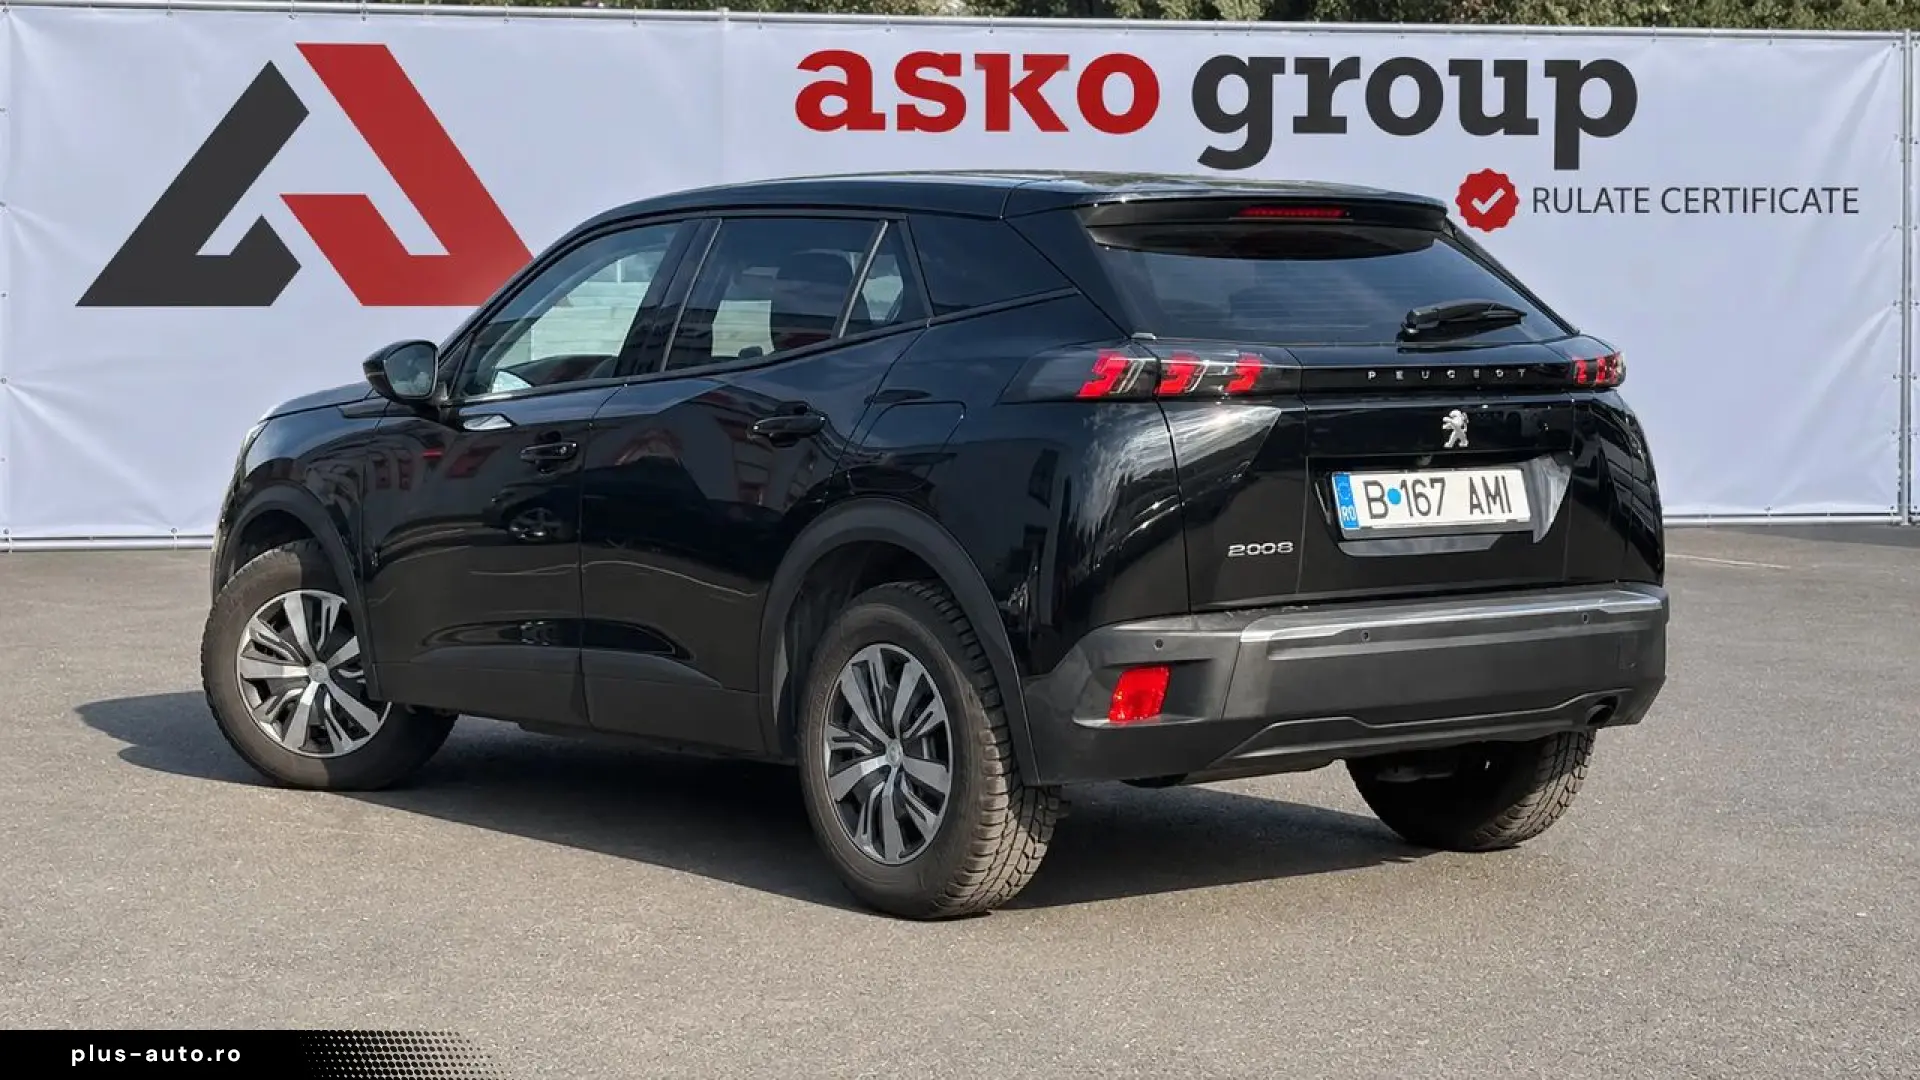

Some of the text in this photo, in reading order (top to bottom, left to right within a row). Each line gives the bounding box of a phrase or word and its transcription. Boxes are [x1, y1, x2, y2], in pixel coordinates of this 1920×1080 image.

[795, 50, 1638, 169] asko group
[1532, 186, 1860, 214] RULATE CERTIFICATE
[1367, 368, 1526, 380] PEUGEOT
[1362, 475, 1513, 520] B 167 AMI
[1340, 506, 1357, 521] RO
[1227, 540, 1294, 558] 2008
